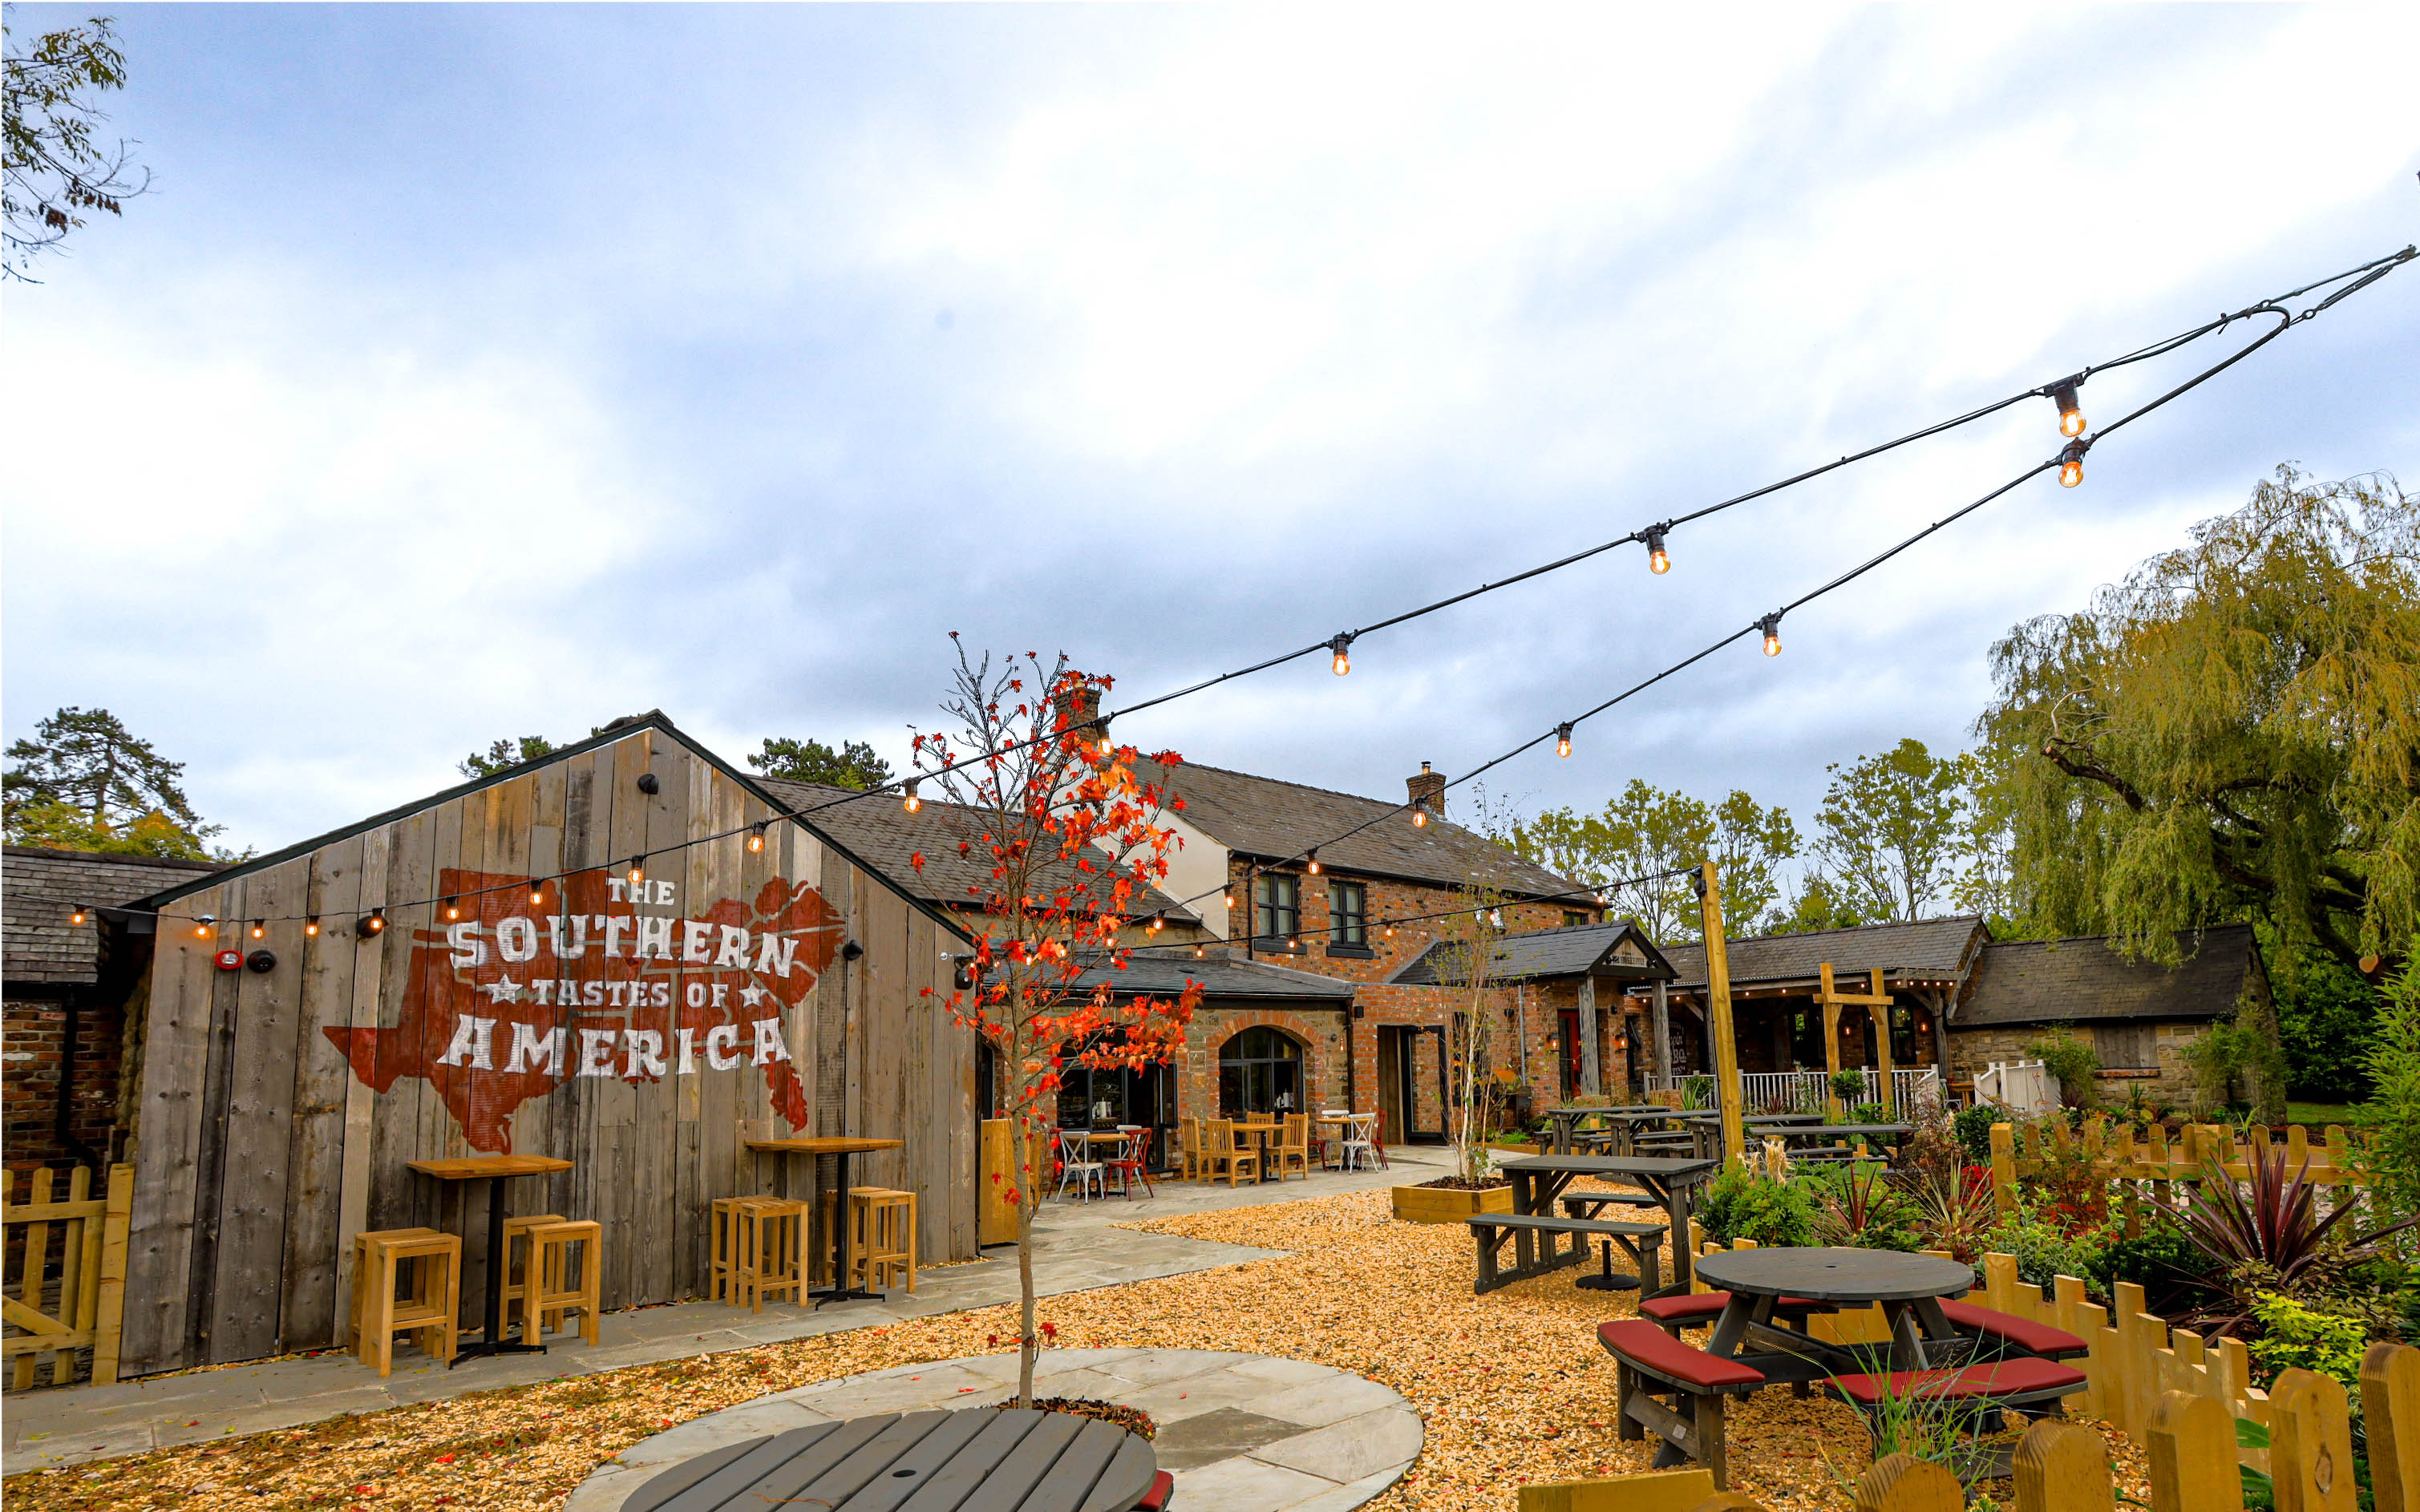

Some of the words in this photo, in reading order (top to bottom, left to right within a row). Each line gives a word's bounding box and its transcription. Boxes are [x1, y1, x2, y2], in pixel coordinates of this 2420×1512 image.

[605, 877, 675, 905] THE
[447, 915, 799, 978] SOUTHERN
[532, 979, 670, 1007] TASTES
[687, 982, 729, 1008] OF
[436, 1013, 792, 1075] AMERICA
